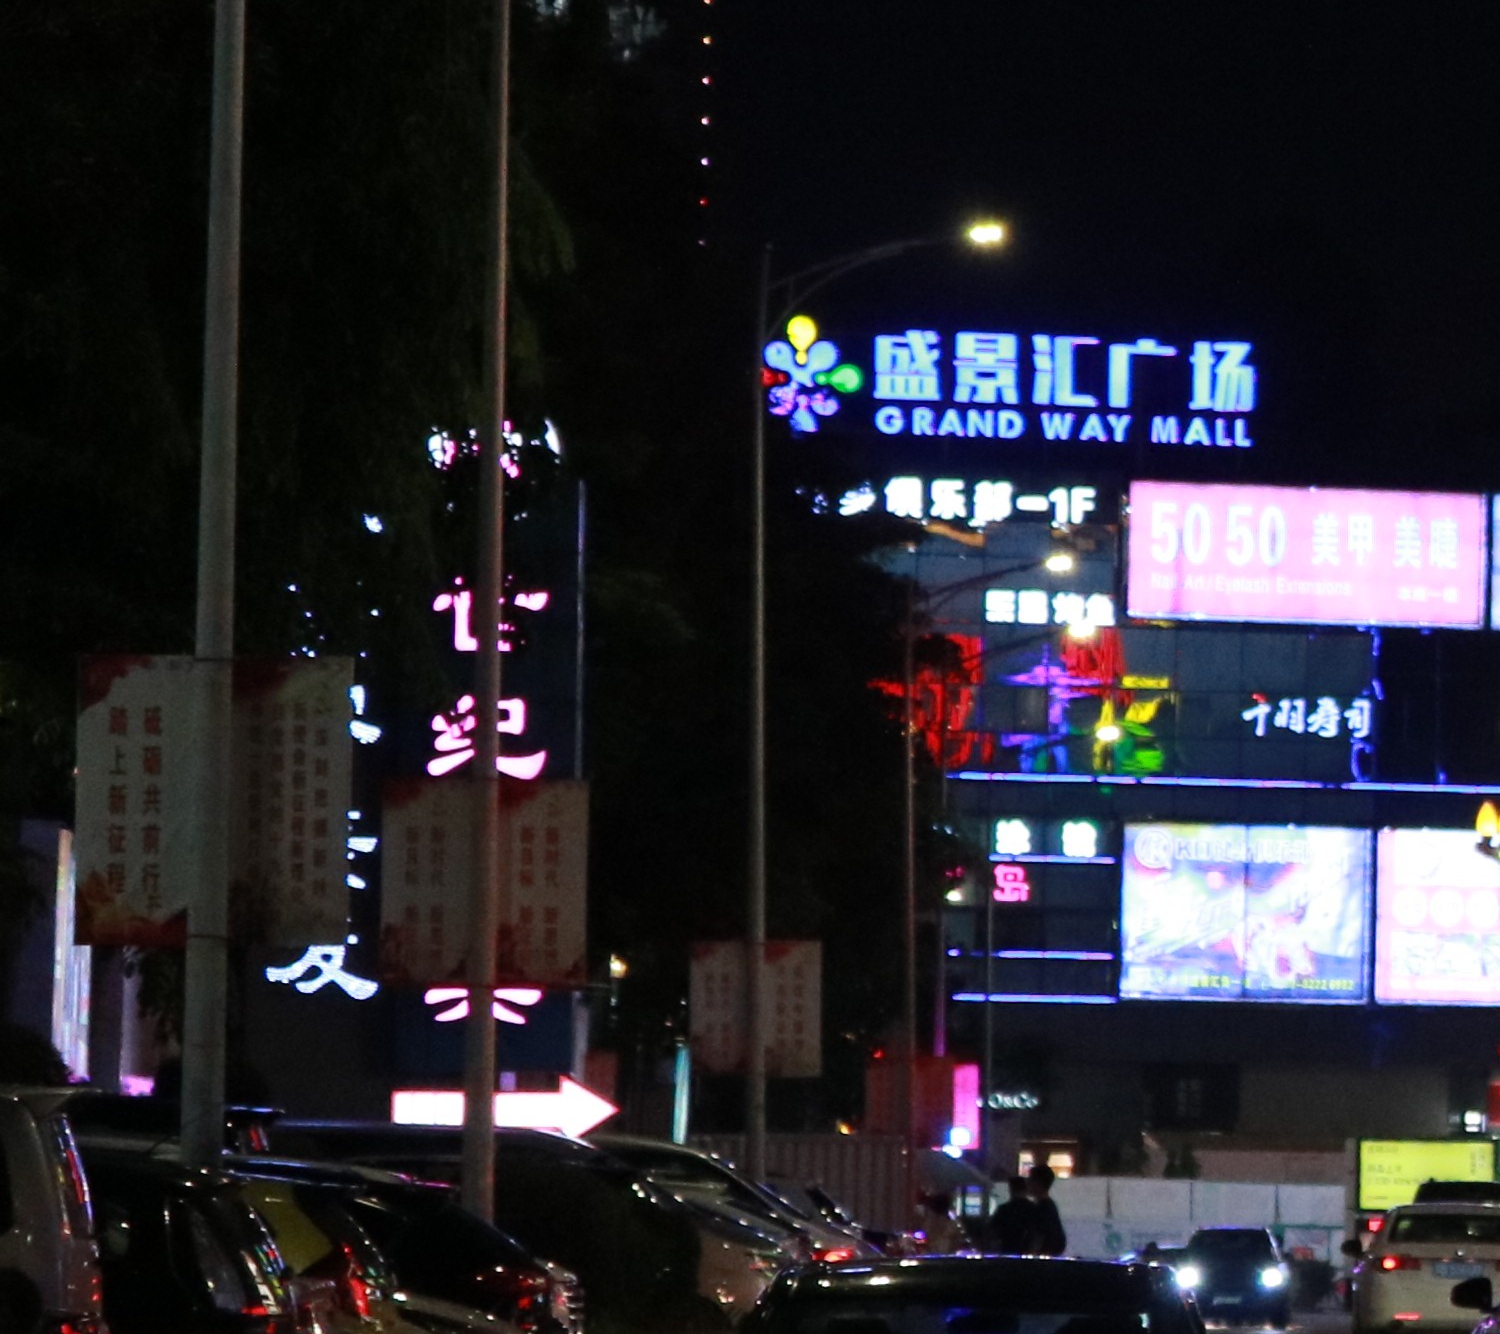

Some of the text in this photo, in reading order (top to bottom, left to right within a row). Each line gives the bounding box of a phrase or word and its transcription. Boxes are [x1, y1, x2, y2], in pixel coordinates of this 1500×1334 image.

[872, 329, 1258, 413] 盛景汇广场
[874, 407, 1254, 448] GRAND WAY MALL
[1311, 512, 1373, 565] 美甲
